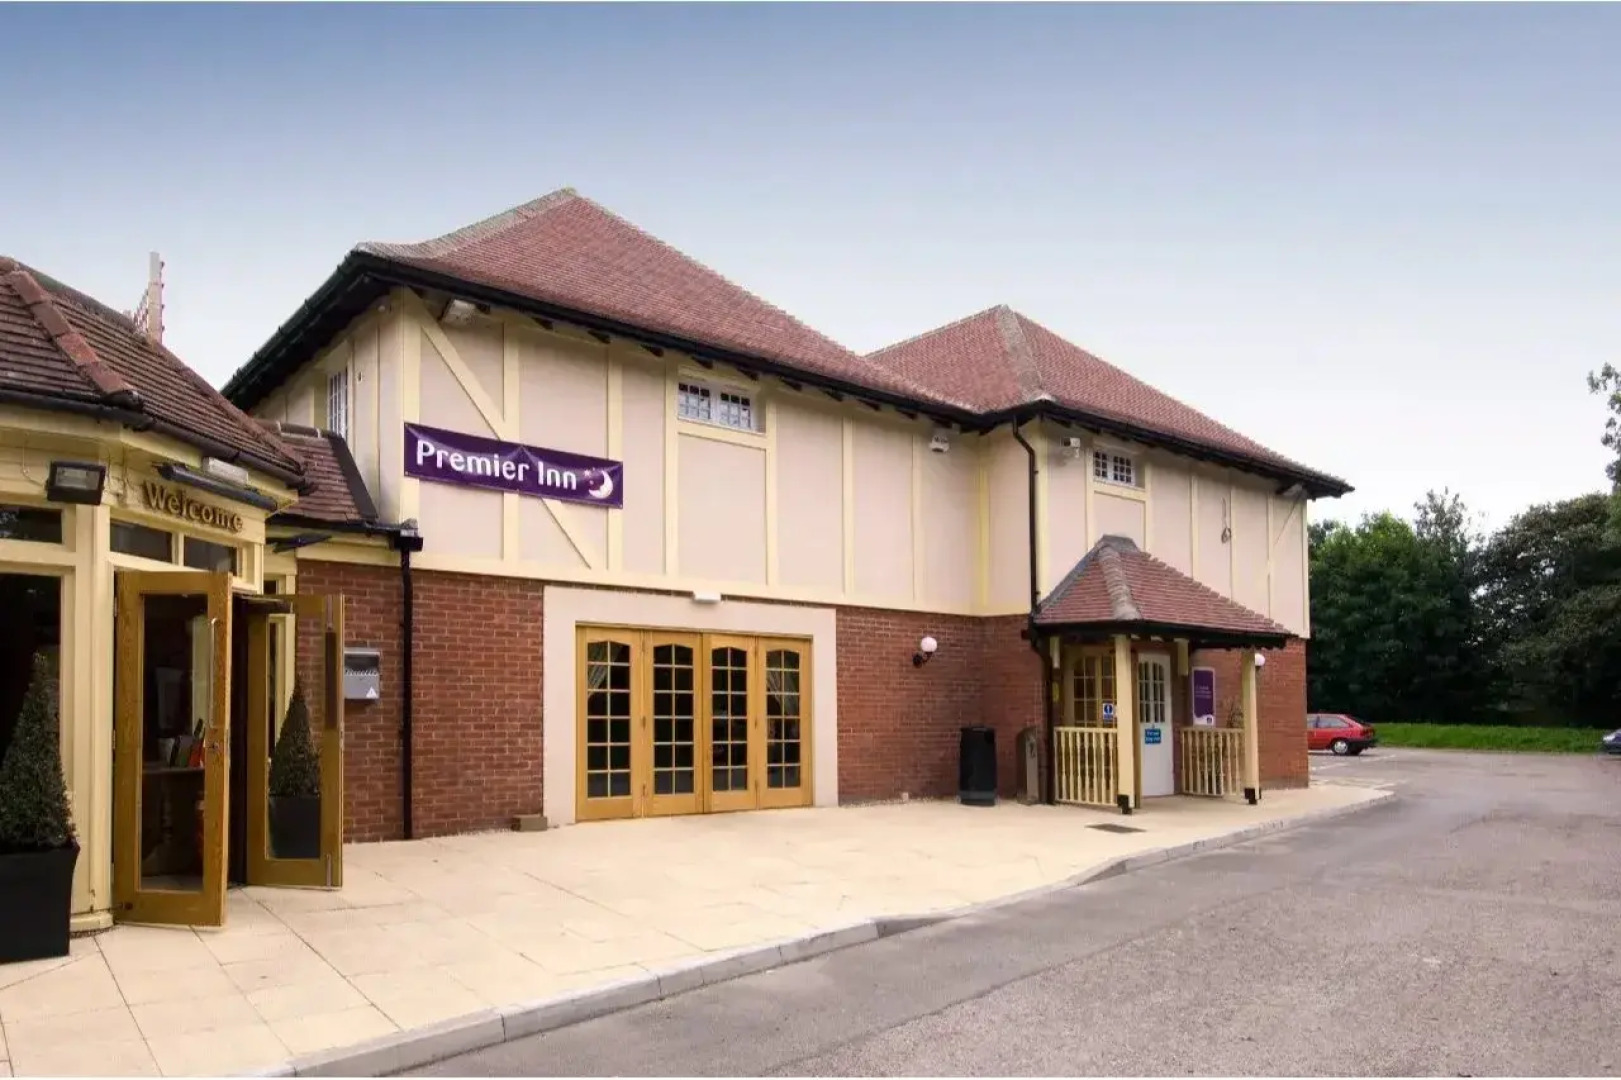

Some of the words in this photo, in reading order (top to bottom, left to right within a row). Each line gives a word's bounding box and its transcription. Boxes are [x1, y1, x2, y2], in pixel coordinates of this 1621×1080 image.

[416, 438, 530, 482] Premier
[537, 461, 577, 490] Inn
[141, 480, 244, 534] Welcome
